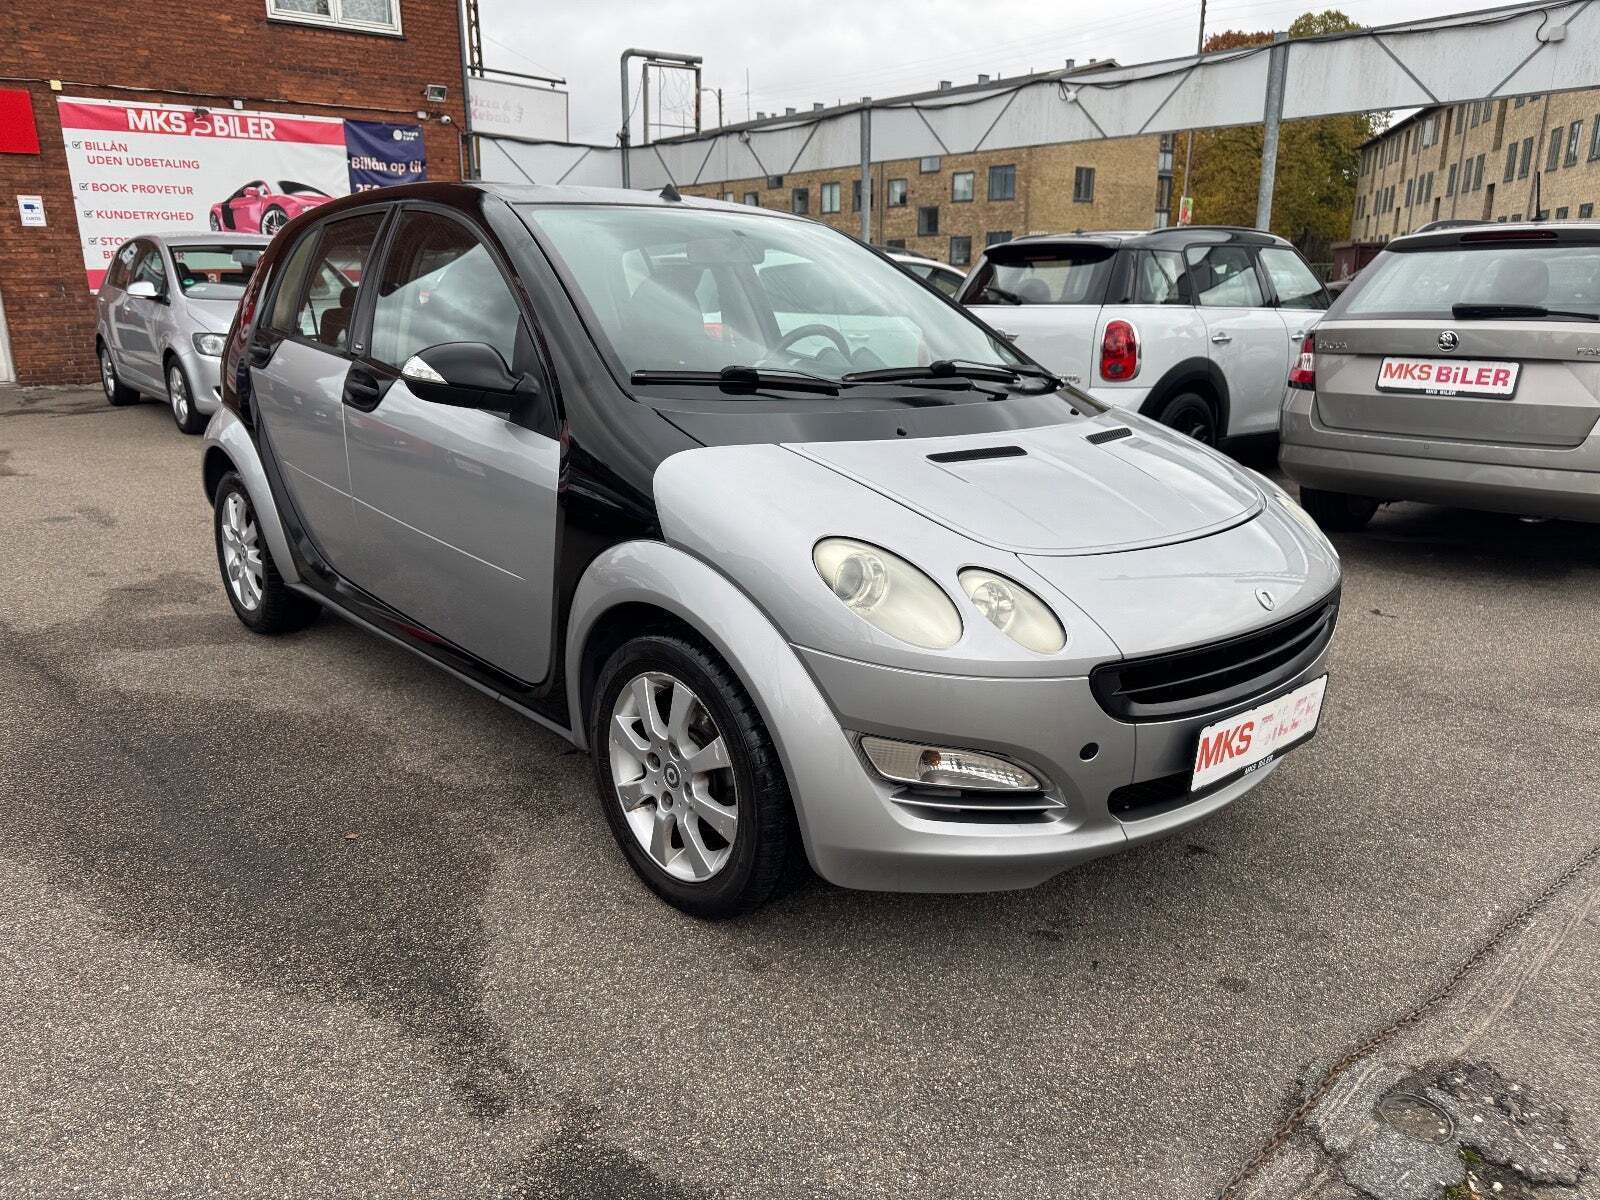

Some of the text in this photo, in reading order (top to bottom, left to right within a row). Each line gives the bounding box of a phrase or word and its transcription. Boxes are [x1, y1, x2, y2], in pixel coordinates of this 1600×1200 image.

[126, 108, 276, 139] MKS BILER
[84, 140, 128, 152] BILLÅN
[87, 155, 200, 169] UDEN UDBETALING
[351, 156, 422, 176] Billån op til
[91, 182, 194, 195] BOOK PRØVETUR
[96, 210, 194, 221] KUNDETRYGHED
[1383, 362, 1433, 381] MKS
[1196, 721, 1255, 773] MKS
